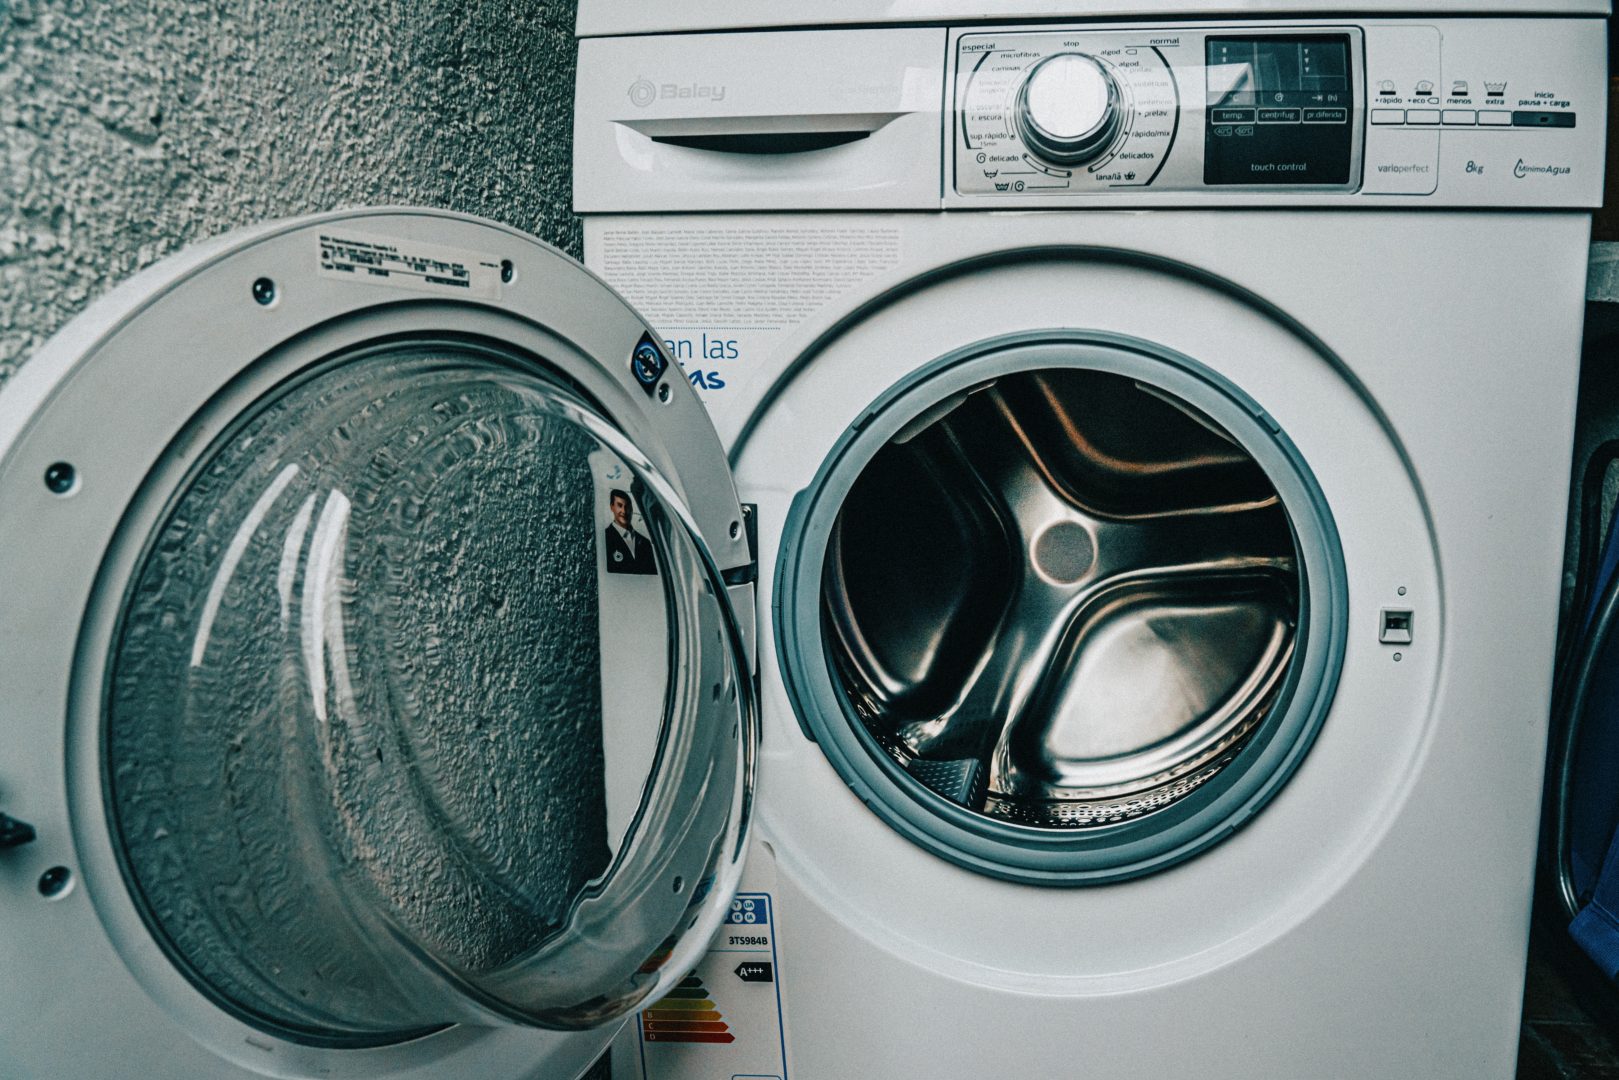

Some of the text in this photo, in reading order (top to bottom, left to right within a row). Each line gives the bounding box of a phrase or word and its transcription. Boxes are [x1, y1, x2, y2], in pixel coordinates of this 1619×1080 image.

[1150, 37, 1179, 46] normal
[962, 43, 995, 51] especial
[661, 83, 725, 101] Balay
[1534, 91, 1554, 99] inicio
[1518, 99, 1541, 107] pausa
[1549, 100, 1570, 109] carga
[989, 154, 1020, 162] delicado
[1119, 152, 1154, 160] delicados
[1251, 163, 1306, 171] touch control
[1378, 164, 1429, 174] varioperfect
[703, 333, 739, 359] las
[729, 936, 769, 945] 3TS984B
[740, 967, 764, 978] A+++
